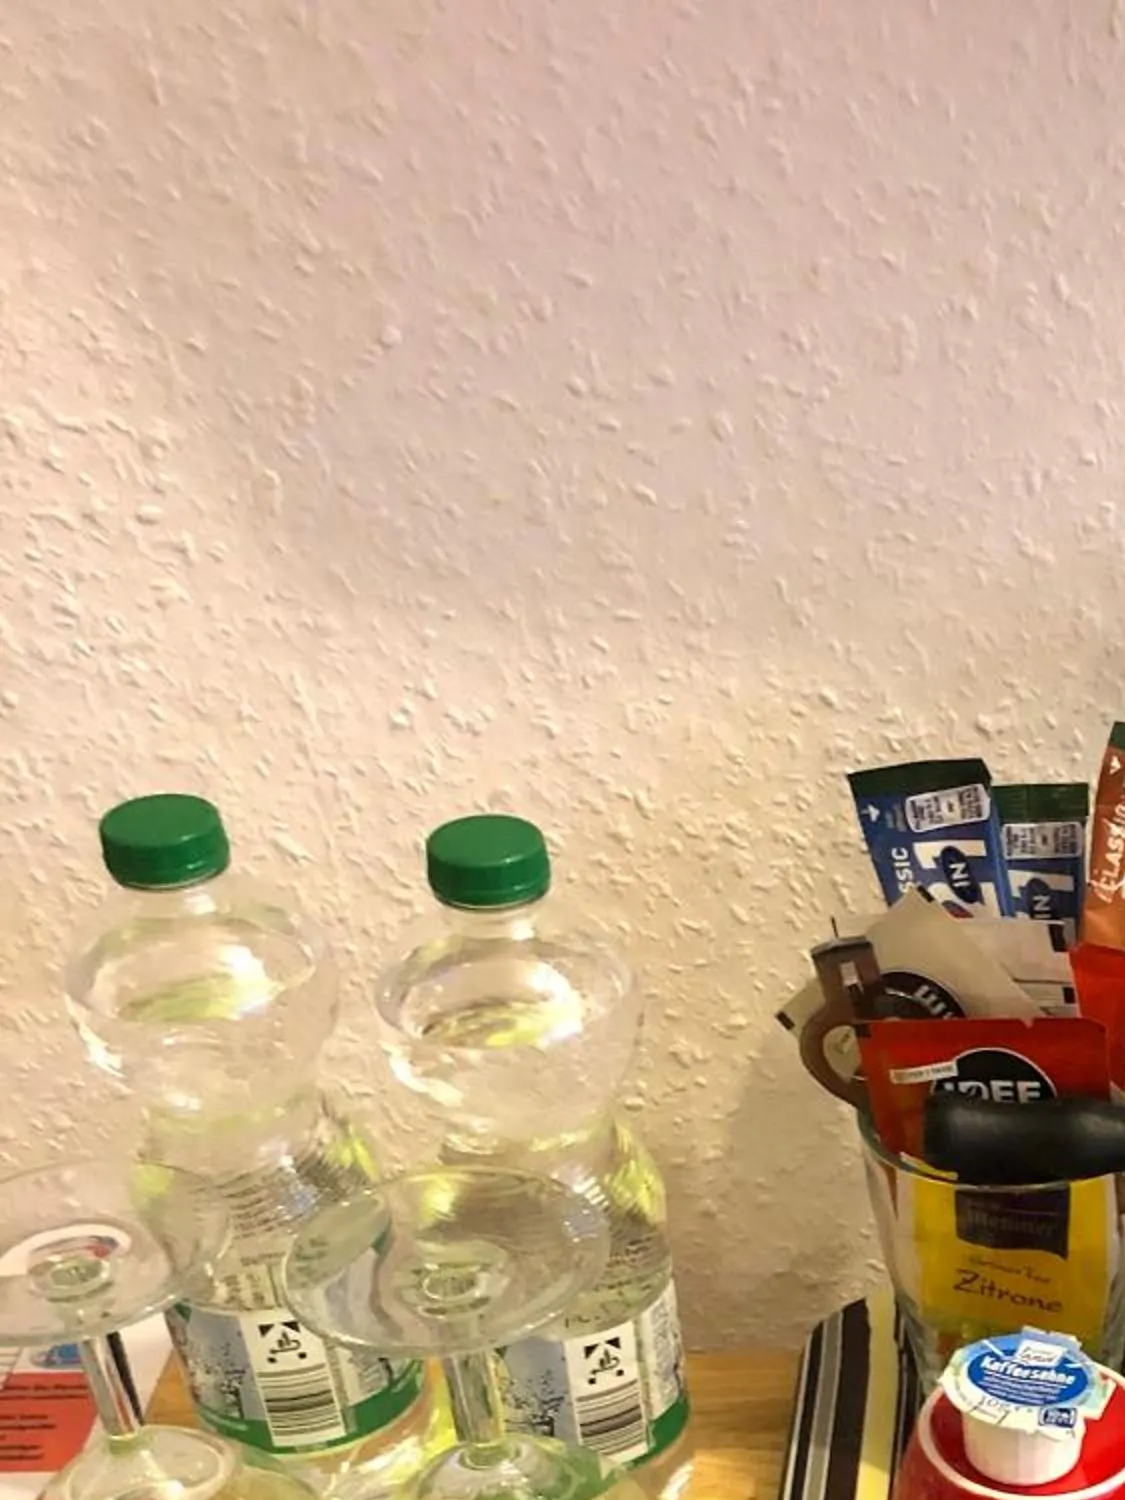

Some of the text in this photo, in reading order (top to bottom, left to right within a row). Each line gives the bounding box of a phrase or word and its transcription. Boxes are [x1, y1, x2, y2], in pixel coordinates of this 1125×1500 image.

[912, 839, 988, 870] 1
[949, 861, 971, 889] IN
[1007, 870, 1075, 897] 1
[1033, 894, 1050, 919] IN
[952, 1267, 1064, 1314] Zitrone
[980, 1354, 1077, 1386] Kaffeesahne
